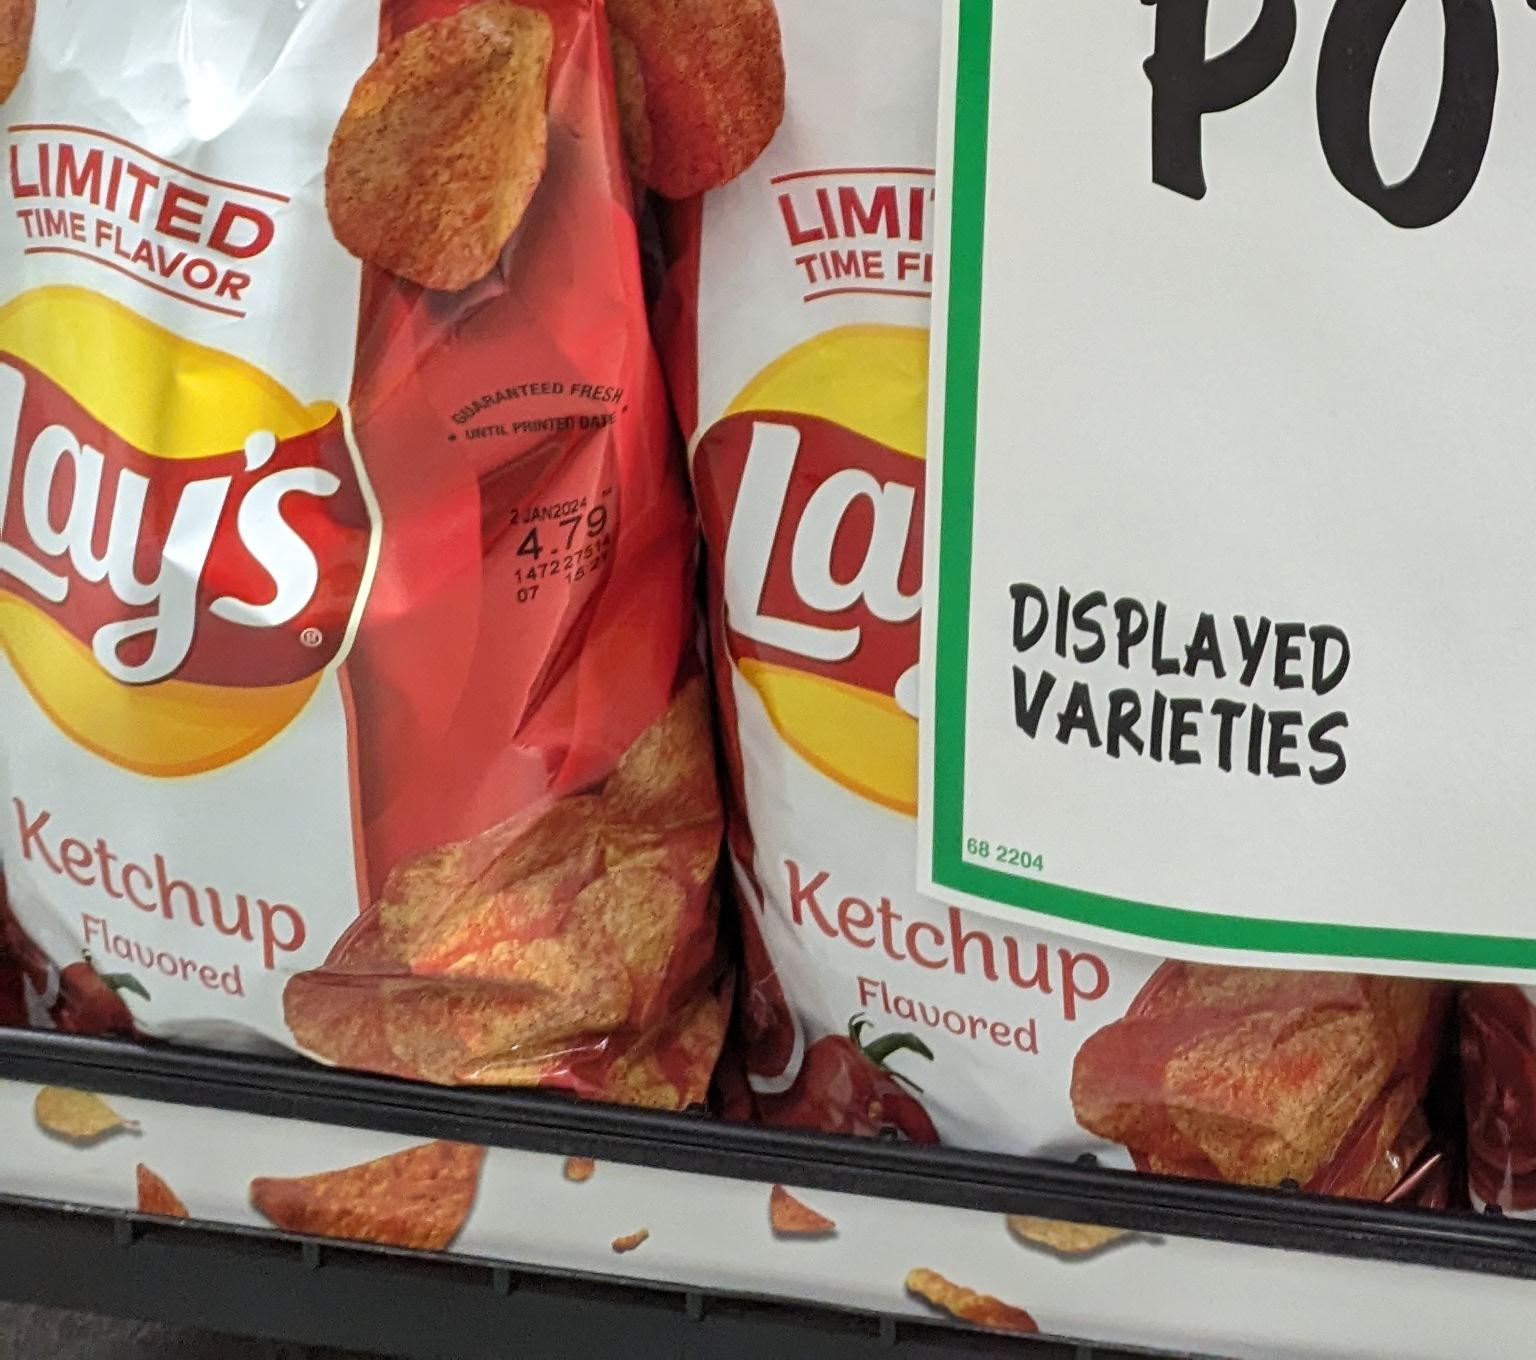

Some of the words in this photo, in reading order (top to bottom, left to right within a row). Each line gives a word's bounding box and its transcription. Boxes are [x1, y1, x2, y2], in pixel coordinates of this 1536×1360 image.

[9, 143, 275, 261] LIMITED
[777, 184, 935, 248] LIMI
[16, 208, 87, 243] TIME
[96, 218, 252, 302] FLAVOR
[795, 250, 885, 285] TIME
[451, 381, 565, 426] GUARANTEED
[570, 382, 625, 405] FRESH
[465, 422, 508, 441] UNTIL
[511, 414, 574, 435] PRINTED
[516, 504, 608, 561] 4.79
[1009, 581, 1352, 697] DISPLAYED
[1011, 664, 1350, 786] VARIETIES
[12, 796, 307, 971] Ketchup
[966, 836, 991, 859] 68
[995, 844, 1045, 872] 2204
[81, 911, 246, 999] Flavored
[783, 859, 1111, 1022] Ketchup
[855, 975, 1040, 1056] Flavored
